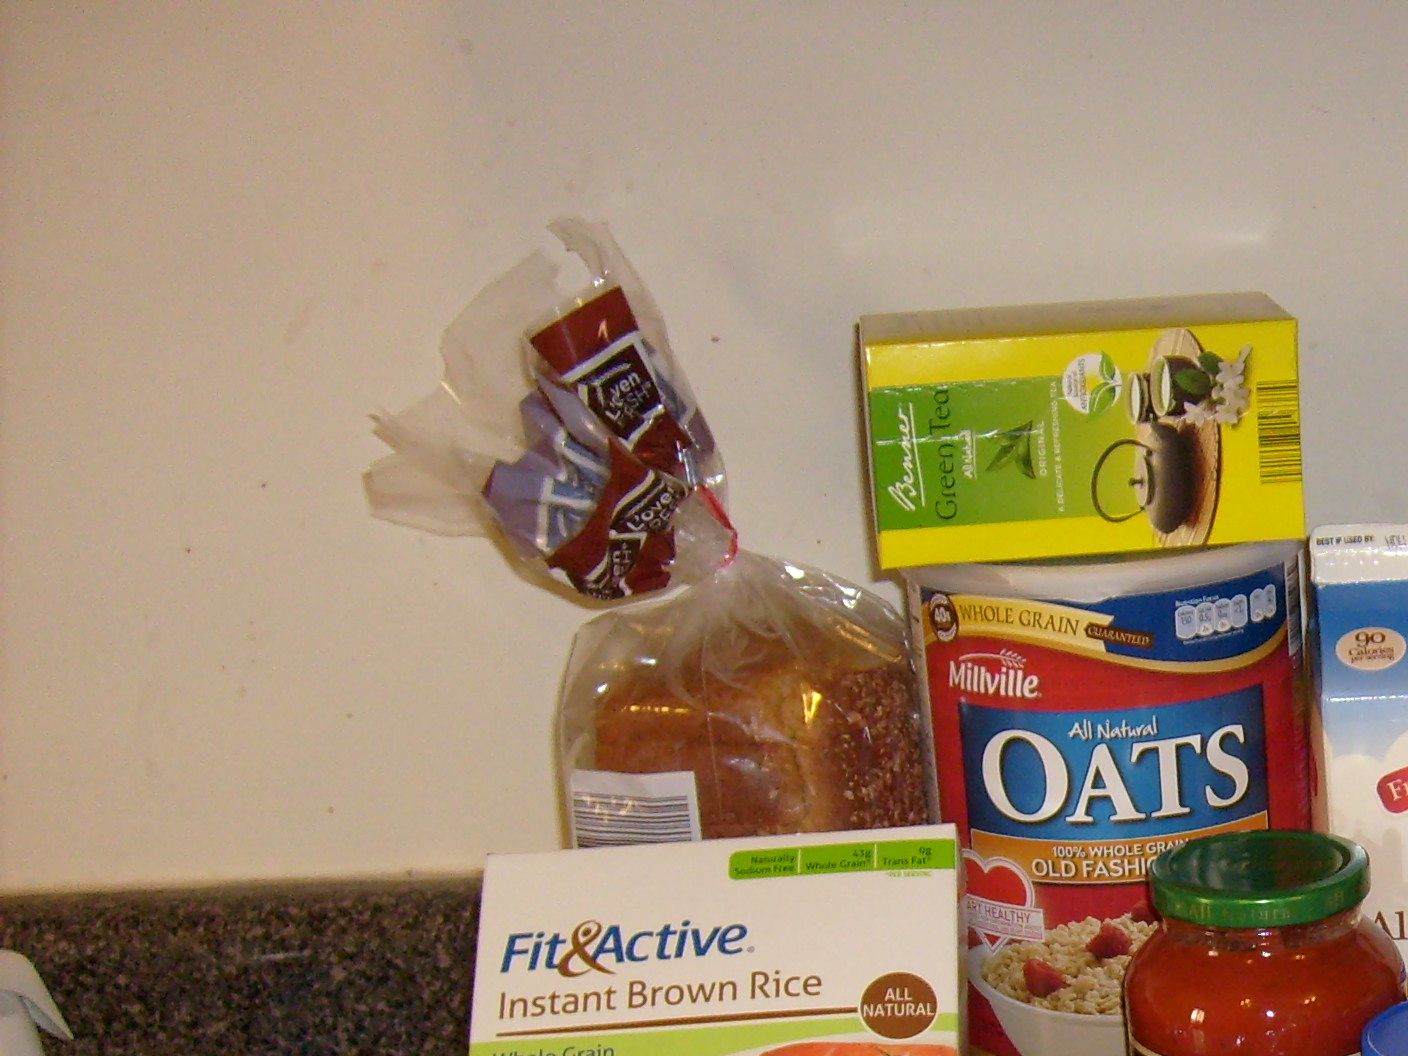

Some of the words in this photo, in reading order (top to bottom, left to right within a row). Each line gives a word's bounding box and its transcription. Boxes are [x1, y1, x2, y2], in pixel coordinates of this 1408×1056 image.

[929, 388, 950, 436] Tea
[935, 443, 957, 520] Green
[959, 603, 1014, 626] WHOLE
[1018, 609, 1080, 637] GRAIN
[949, 660, 1041, 698] Millville
[1068, 719, 1094, 740] All
[1097, 714, 1159, 740] Natural
[981, 723, 1250, 825] OATS
[883, 857, 909, 867] Trans
[1052, 845, 1086, 858] 100%
[1088, 842, 1143, 857] WHOLE
[805, 860, 838, 872] Whole
[1032, 858, 1079, 878] OLD
[500, 919, 748, 978] Fit&Active
[499, 982, 617, 1021] Instant
[628, 979, 738, 1010] Brown
[749, 970, 823, 1000] Rice
[884, 987, 913, 1002] ALL
[863, 1002, 935, 1018] NATURAL
